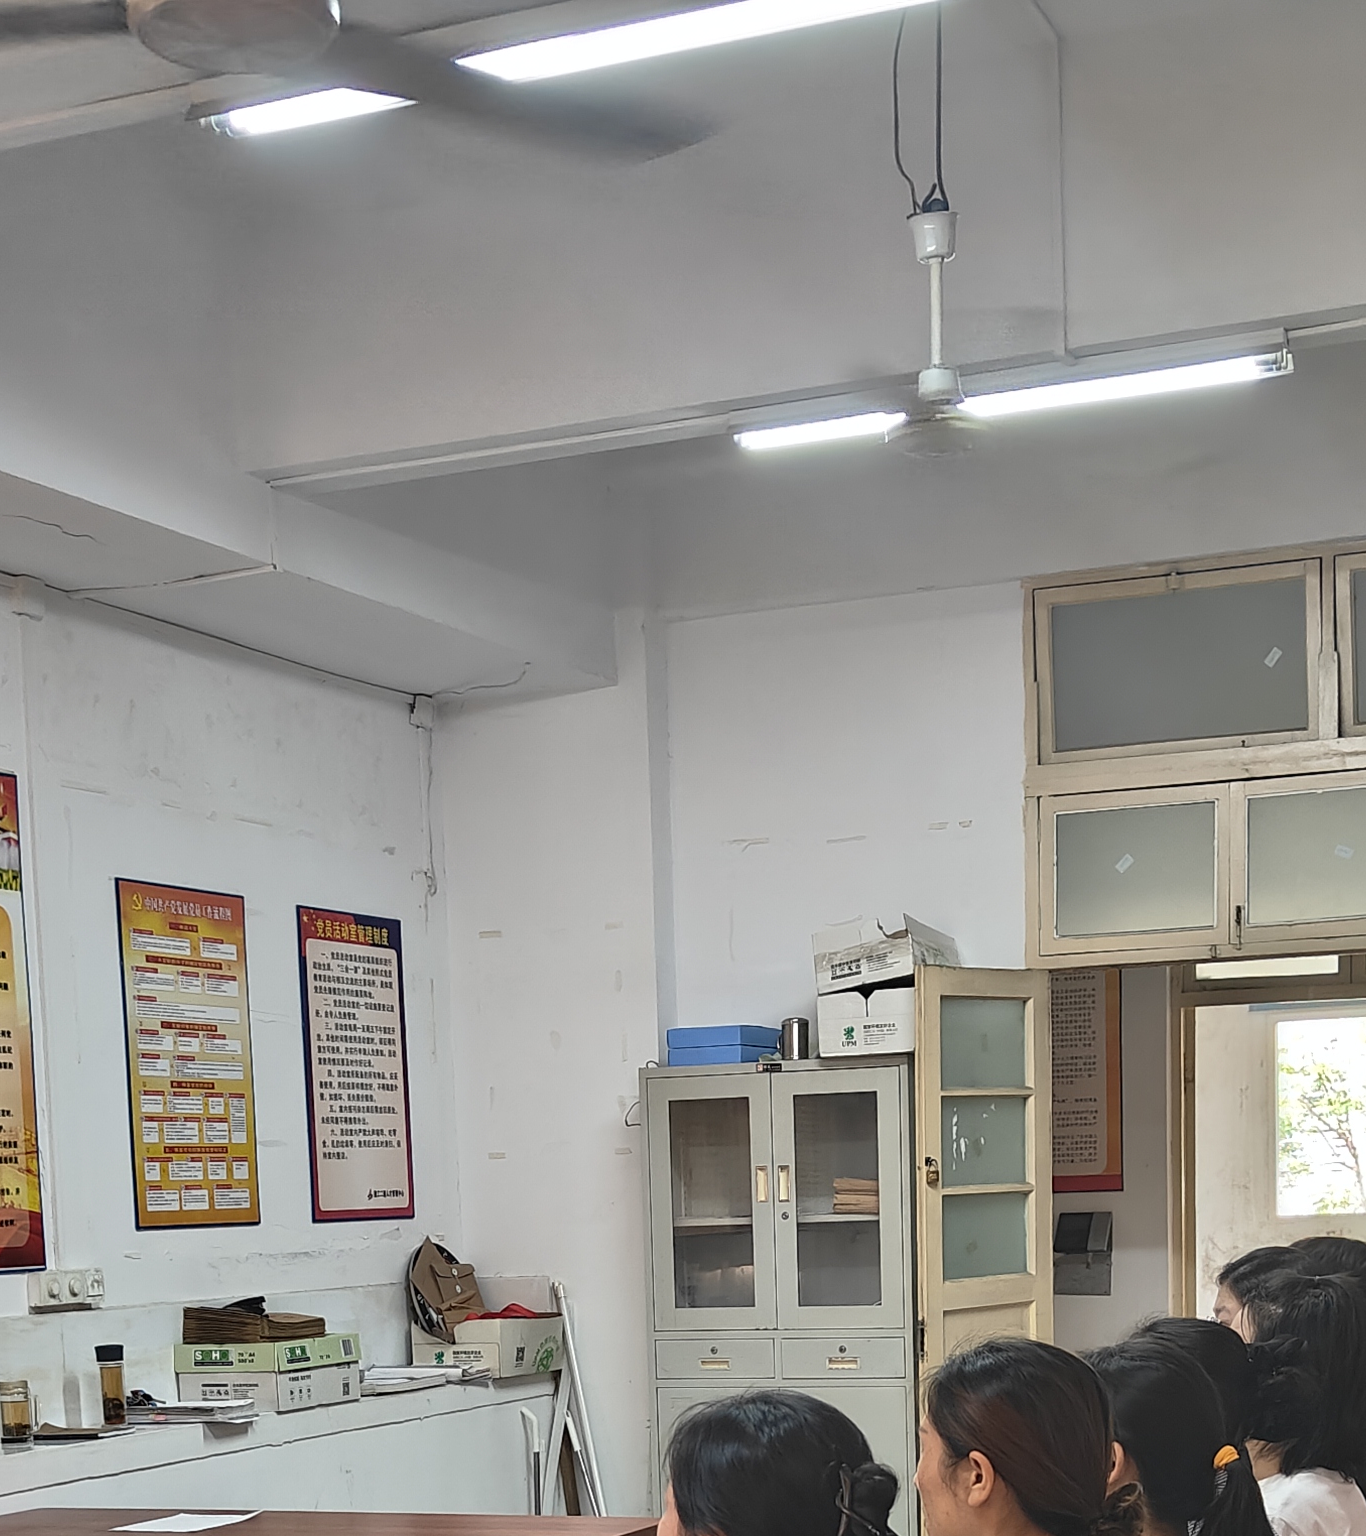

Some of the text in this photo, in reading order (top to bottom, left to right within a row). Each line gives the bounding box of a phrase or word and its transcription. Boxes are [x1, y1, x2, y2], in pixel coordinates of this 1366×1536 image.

[316, 918, 390, 946] 党员活动室管理制度
